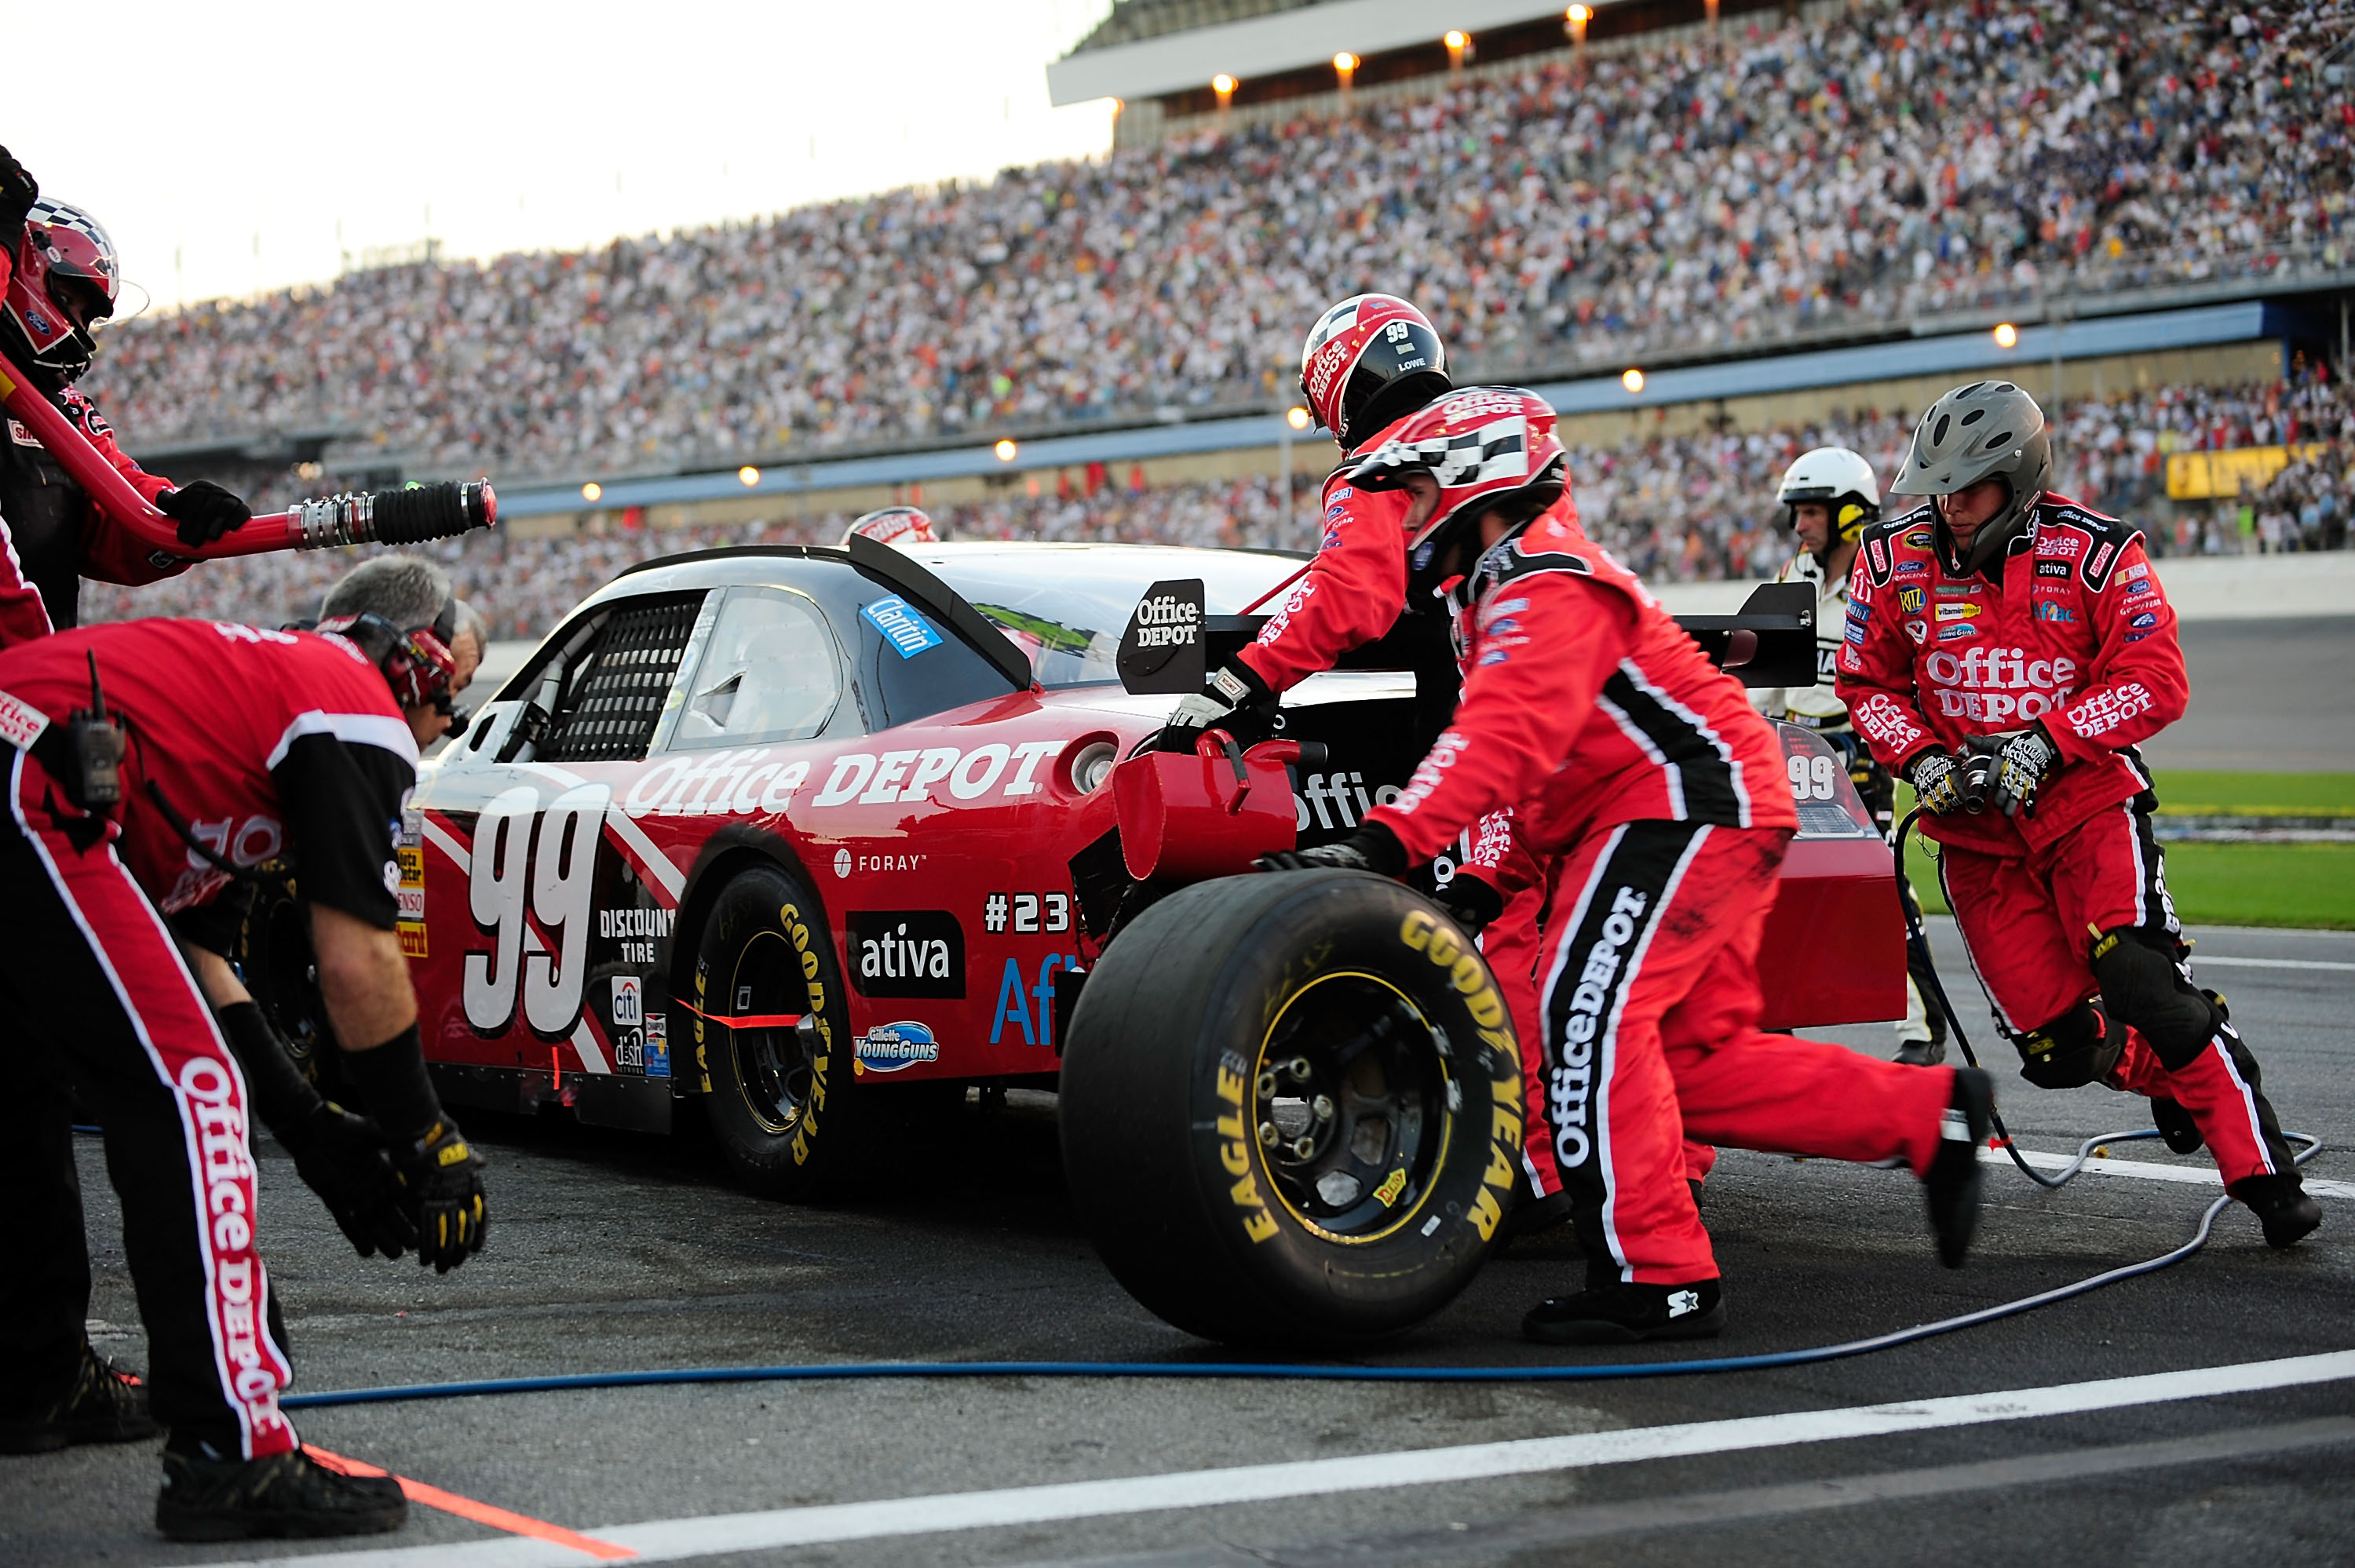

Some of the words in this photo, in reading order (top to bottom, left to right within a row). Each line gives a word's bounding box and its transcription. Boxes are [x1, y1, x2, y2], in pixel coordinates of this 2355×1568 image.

[28, 315, 46, 332] Ford
[1386, 323, 1408, 343] 99
[1310, 340, 1343, 394] Office
[1316, 346, 1349, 403] DEPOT
[1398, 358, 1426, 371] LOWE
[1443, 392, 1521, 414] Office
[1871, 540, 1886, 571] SIMPSON
[2039, 562, 2067, 575] ativa
[2091, 543, 2112, 575] SIMPSON
[1891, 572, 1932, 582] RACING
[1137, 596, 1197, 625] Office
[1899, 588, 1922, 612] RITZ
[867, 599, 928, 651] Claritin
[1137, 625, 1197, 647] DEPOT
[1927, 647, 2076, 688] Office
[1934, 686, 2075, 724] DEPOT
[2068, 683, 2145, 725] Office
[2073, 691, 2152, 738] DEPOT
[627, 748, 811, 819] Office
[812, 740, 1068, 808] DEPOT
[1788, 756, 1835, 800] 99
[397, 893, 422, 911] ENSO
[463, 783, 612, 1034] 99
[601, 908, 676, 939] DISCOUNT
[621, 943, 655, 964] TIRE
[861, 924, 949, 978] ativa
[1569, 886, 1643, 1016] DEPOT
[614, 989, 637, 1019] citi
[693, 962, 714, 1093] EAGLE
[869, 1028, 900, 1041] Gillette
[615, 1027, 644, 1067] dish
[1550, 1014, 1597, 1168] Office
[179, 1056, 253, 1253] Office
[1217, 1065, 1280, 1244] EAGLE
